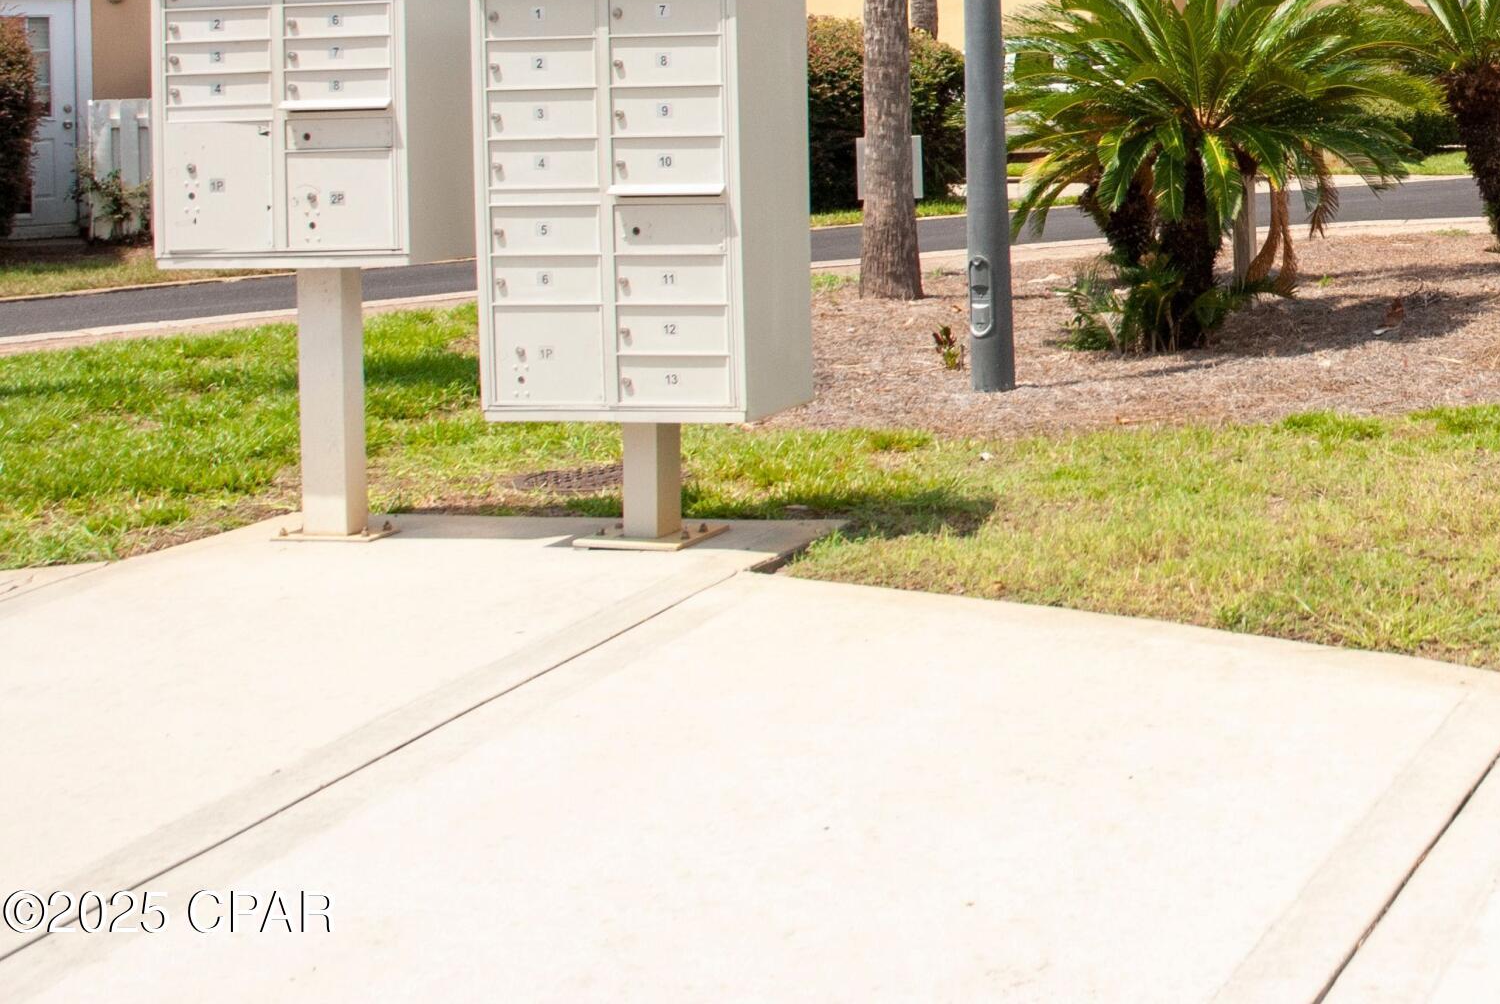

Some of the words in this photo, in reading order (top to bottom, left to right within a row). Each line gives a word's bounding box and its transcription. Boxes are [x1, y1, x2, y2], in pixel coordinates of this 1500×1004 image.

[535, 9, 541, 19] 1
[659, 5, 666, 16] 7
[213, 19, 220, 30] 2
[331, 14, 339, 26] 6
[213, 51, 221, 62] 3
[331, 46, 340, 58] 7
[536, 58, 543, 69] 2
[660, 55, 668, 67] 8
[213, 83, 222, 94] 4
[332, 79, 340, 91] 8
[537, 108, 544, 120] 3
[661, 105, 669, 117] 9
[537, 158, 545, 169] 4
[659, 156, 672, 168] 10
[330, 193, 345, 205] 2P
[540, 224, 548, 236] 5
[541, 274, 549, 285] 6
[662, 274, 675, 285] 11
[663, 324, 676, 335] 12
[664, 374, 678, 385] 13
